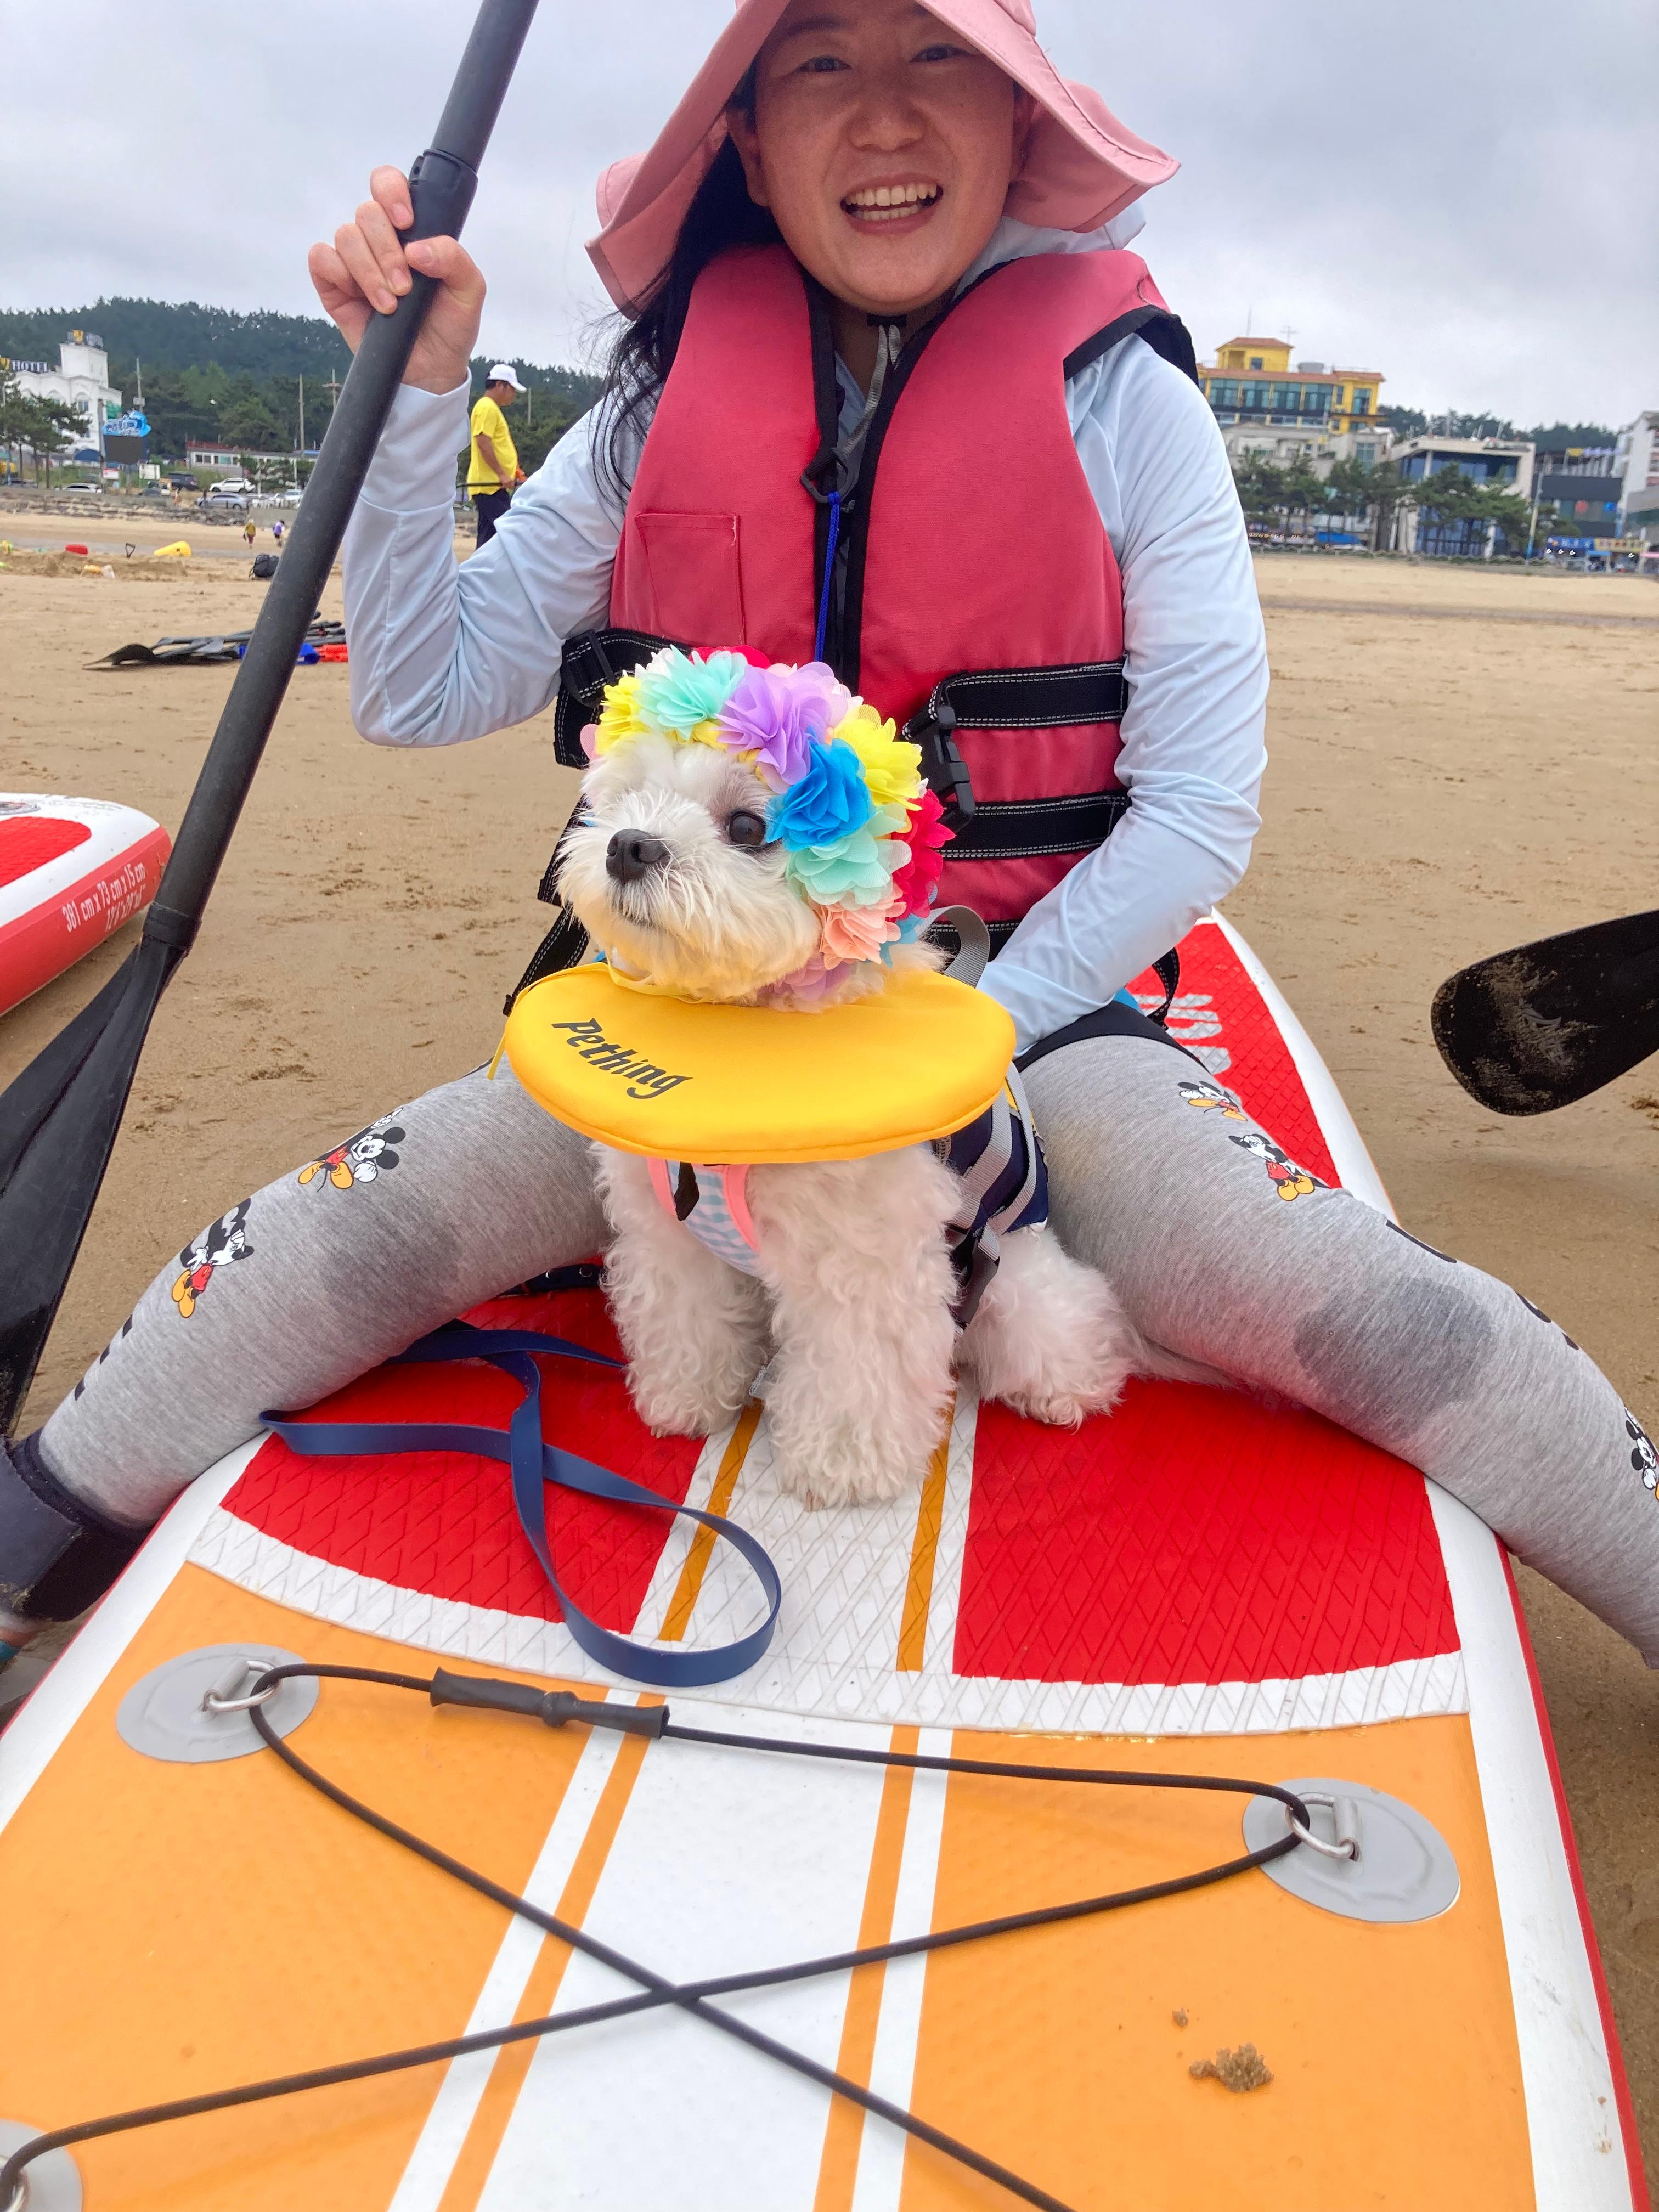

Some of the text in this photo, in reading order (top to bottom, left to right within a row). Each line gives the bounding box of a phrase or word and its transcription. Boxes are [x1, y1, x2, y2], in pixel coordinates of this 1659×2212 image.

[62, 862, 146, 932] 381 cm x 73 cm x 15 cm
[551, 1018, 693, 1099] Pething
